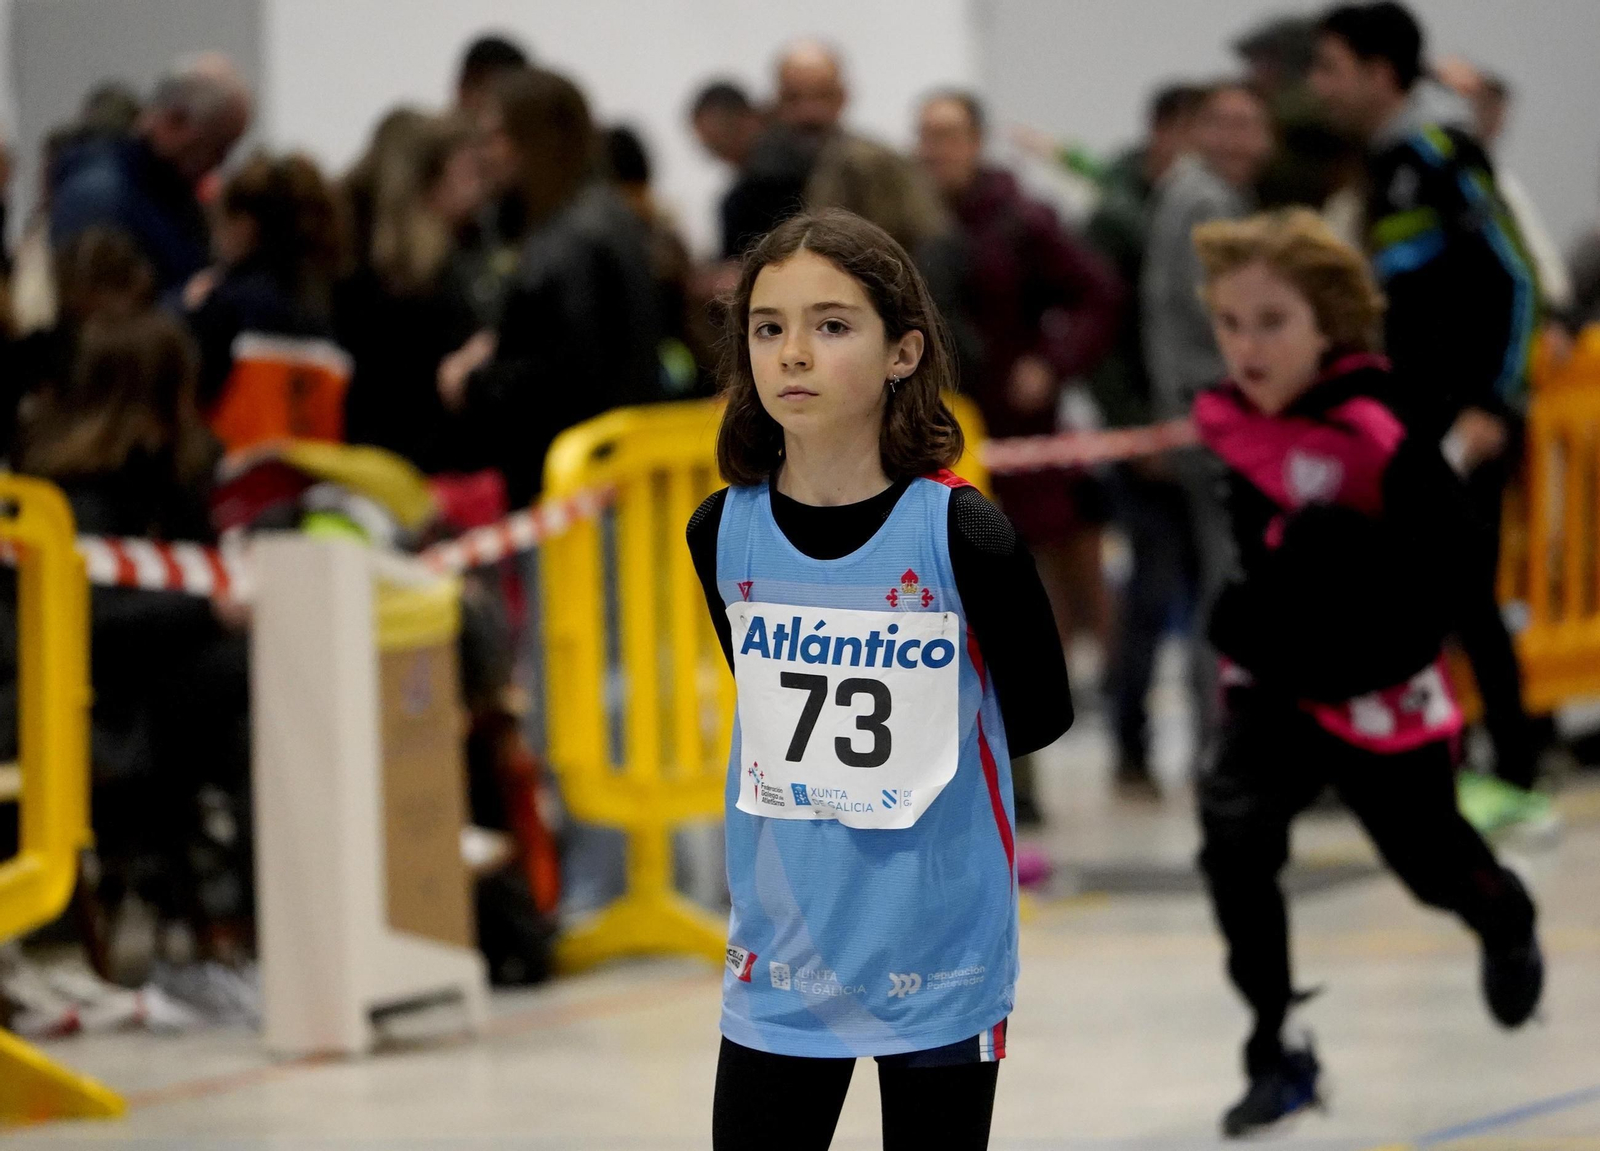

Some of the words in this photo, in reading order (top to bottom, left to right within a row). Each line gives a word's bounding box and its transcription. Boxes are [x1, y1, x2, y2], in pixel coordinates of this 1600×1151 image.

[740, 616, 956, 669] Atlántico
[780, 671, 892, 768] 73
[810, 787, 848, 800] XUNTA
[795, 966, 838, 982] XUNTA
[812, 982, 867, 997] GALICIA
